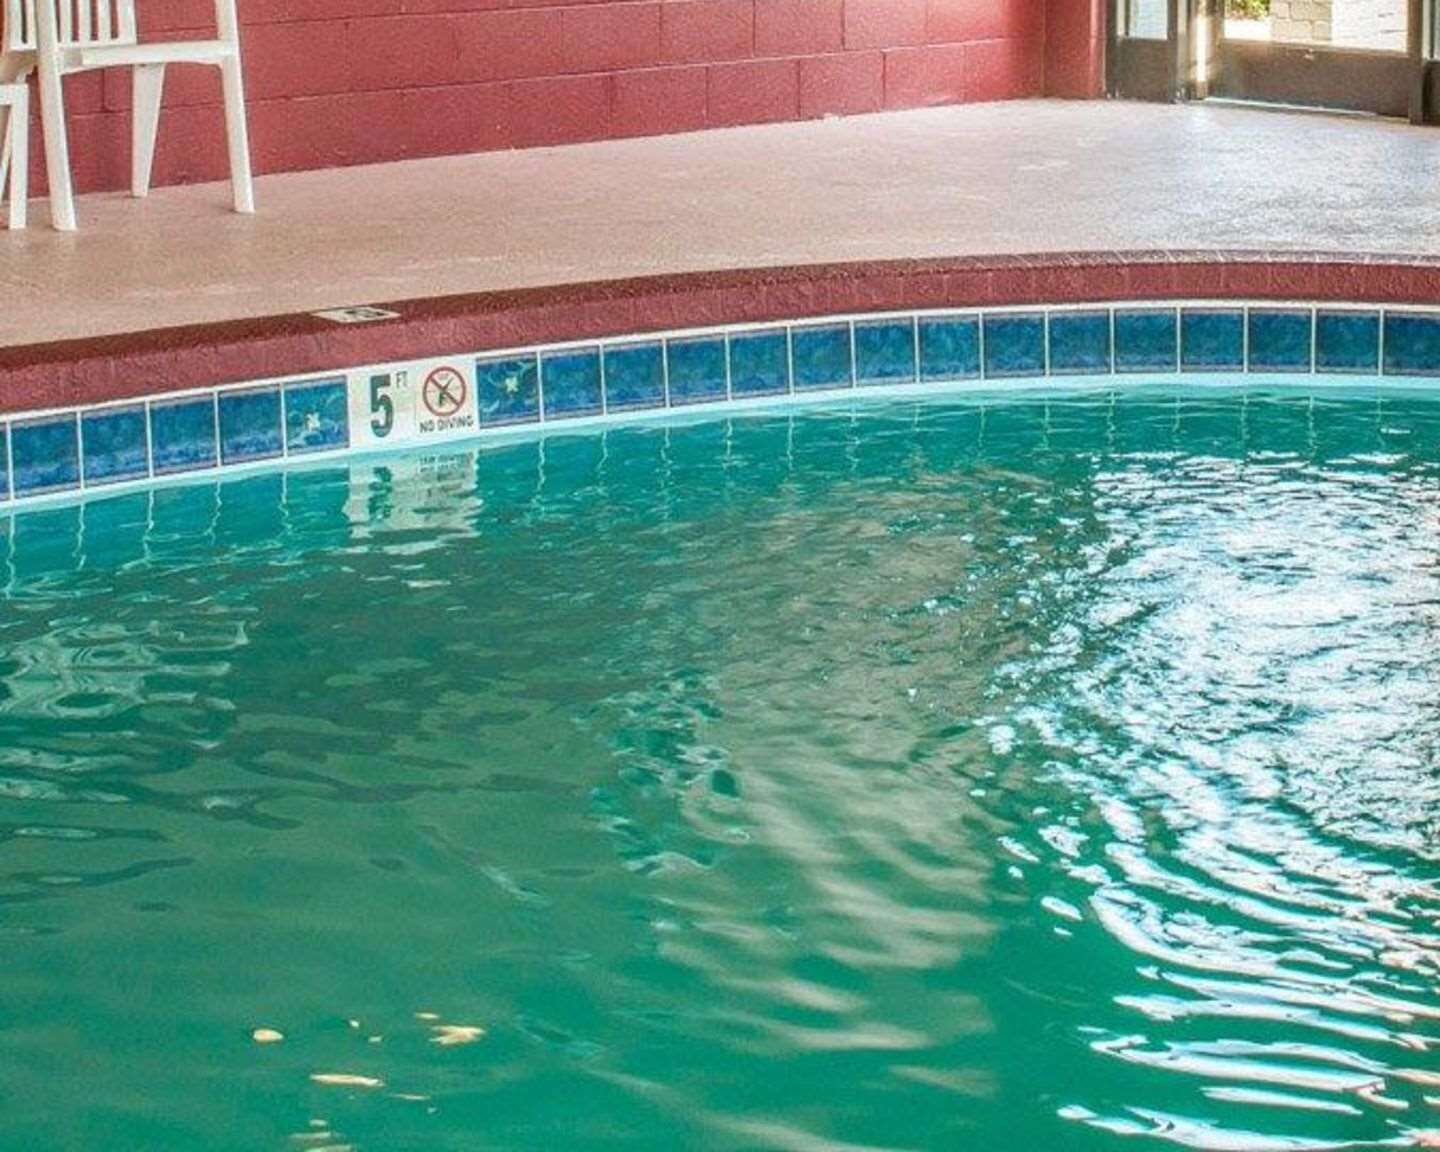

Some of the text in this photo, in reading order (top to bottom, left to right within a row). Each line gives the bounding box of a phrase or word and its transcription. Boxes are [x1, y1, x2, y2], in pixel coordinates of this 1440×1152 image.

[370, 371, 408, 438] 5 FT
[419, 415, 474, 433] NO DIVING
